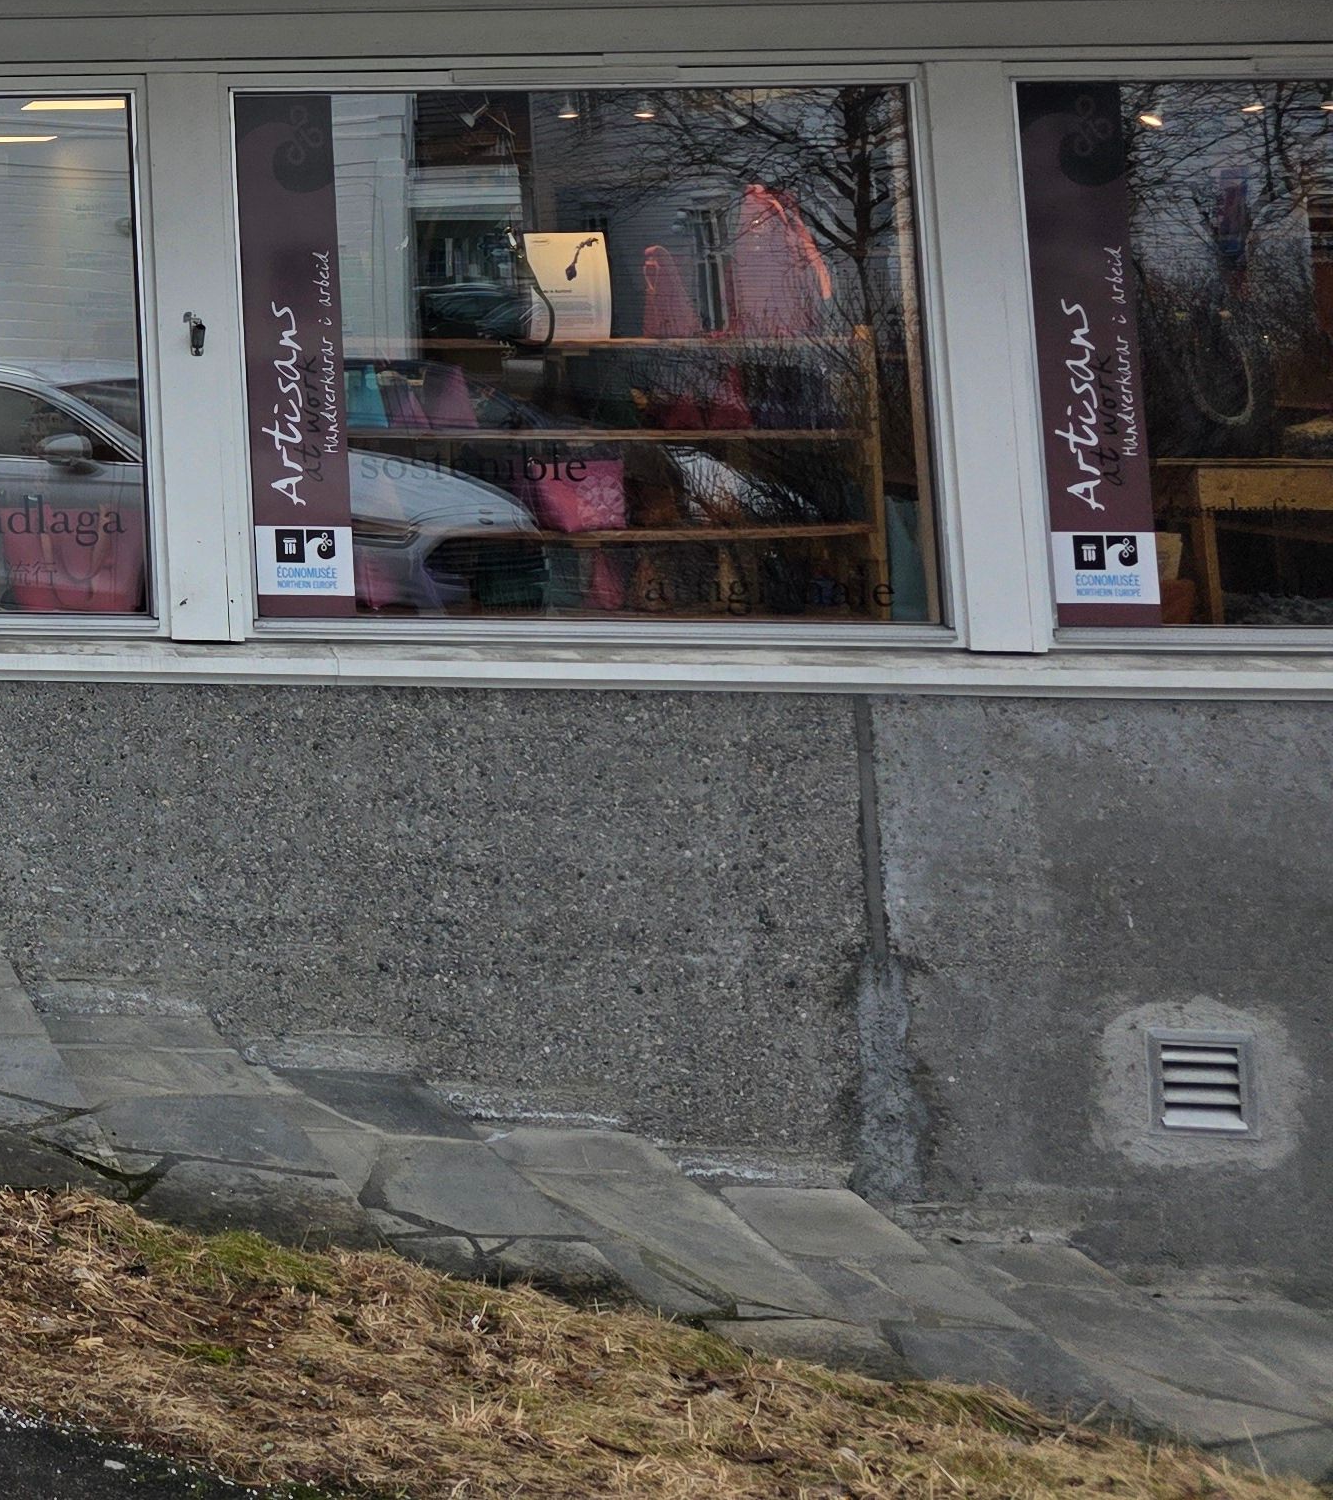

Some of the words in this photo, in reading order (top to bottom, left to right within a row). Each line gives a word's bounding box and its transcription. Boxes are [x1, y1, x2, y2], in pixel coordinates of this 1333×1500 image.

[312, 249, 331, 305] arbeid
[1103, 245, 1126, 305] arbeid
[262, 300, 307, 507] Artisans
[296, 355, 321, 433] work
[1055, 298, 1106, 512] Artisans
[1094, 353, 1121, 434] work
[294, 441, 323, 483] at
[361, 442, 588, 483] sostenible
[1089, 446, 1123, 487] at
[276, 565, 338, 579] ÉCONOMUSÉE
[277, 579, 311, 588] NORTHERN
[313, 580, 338, 589] EUROPE
[1075, 572, 1140, 587] ÉCONOMUSÉE
[1076, 588, 1112, 597] NORTHERN
[1114, 588, 1141, 597] EUROPE
